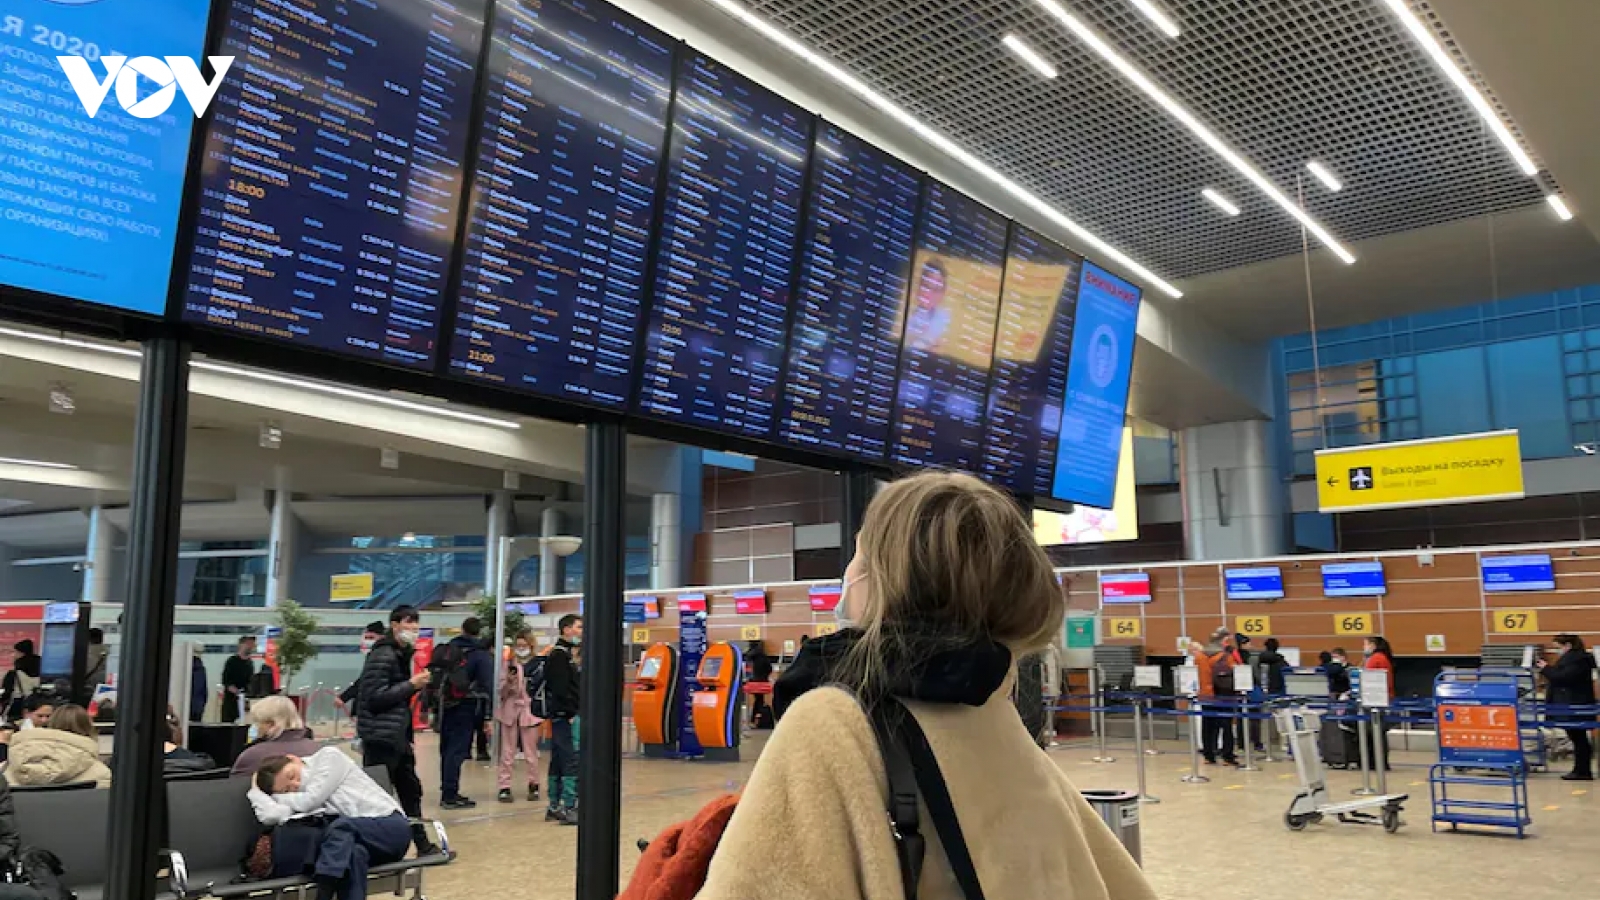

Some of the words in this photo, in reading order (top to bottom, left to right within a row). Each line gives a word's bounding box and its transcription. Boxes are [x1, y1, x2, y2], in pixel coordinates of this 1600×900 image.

[31, 24, 100, 62] 2020
[228, 177, 266, 199] 18:00
[467, 348, 496, 364] 21:00
[1117, 621, 1135, 635] 64
[1243, 618, 1264, 633] 65
[1342, 616, 1365, 631] 66
[1503, 613, 1528, 629] 67
